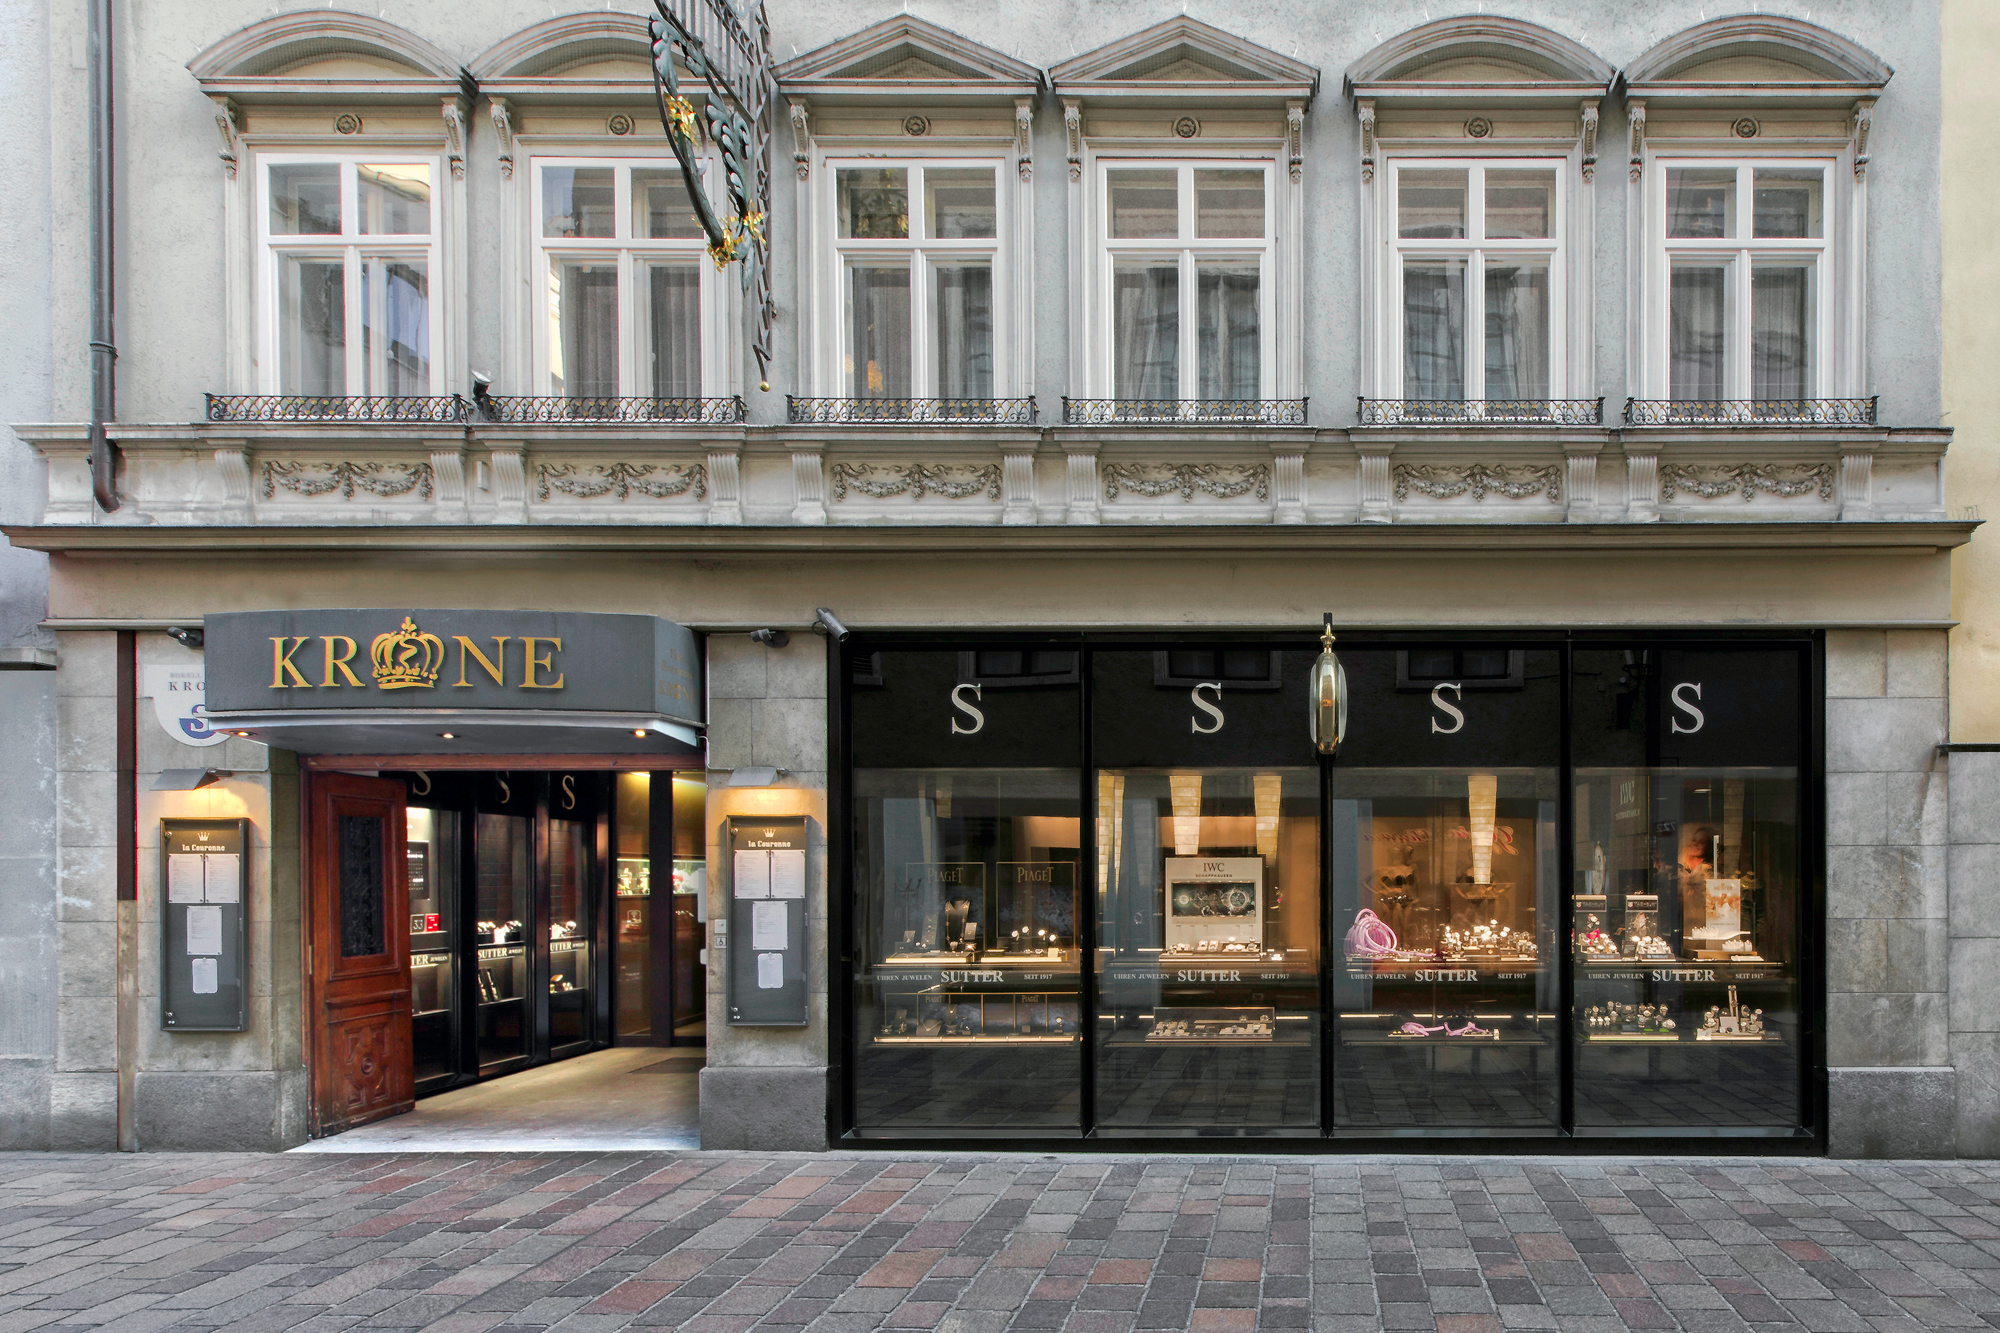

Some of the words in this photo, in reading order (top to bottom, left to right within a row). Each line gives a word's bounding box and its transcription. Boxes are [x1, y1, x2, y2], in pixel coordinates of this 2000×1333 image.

[951, 683, 985, 734] S
[1191, 683, 1225, 734] S
[1431, 683, 1465, 734] S
[1671, 683, 1705, 734] S
[562, 774, 576, 810] S
[927, 867, 964, 883] PIAGET
[1017, 866, 1054, 883] PIAGET
[1203, 862, 1225, 872] IWC
[940, 970, 1004, 983] SUTTER
[1177, 969, 1241, 982] SUTTER
[1414, 969, 1478, 982] SUTTER
[1652, 969, 1715, 982] SUTTER
